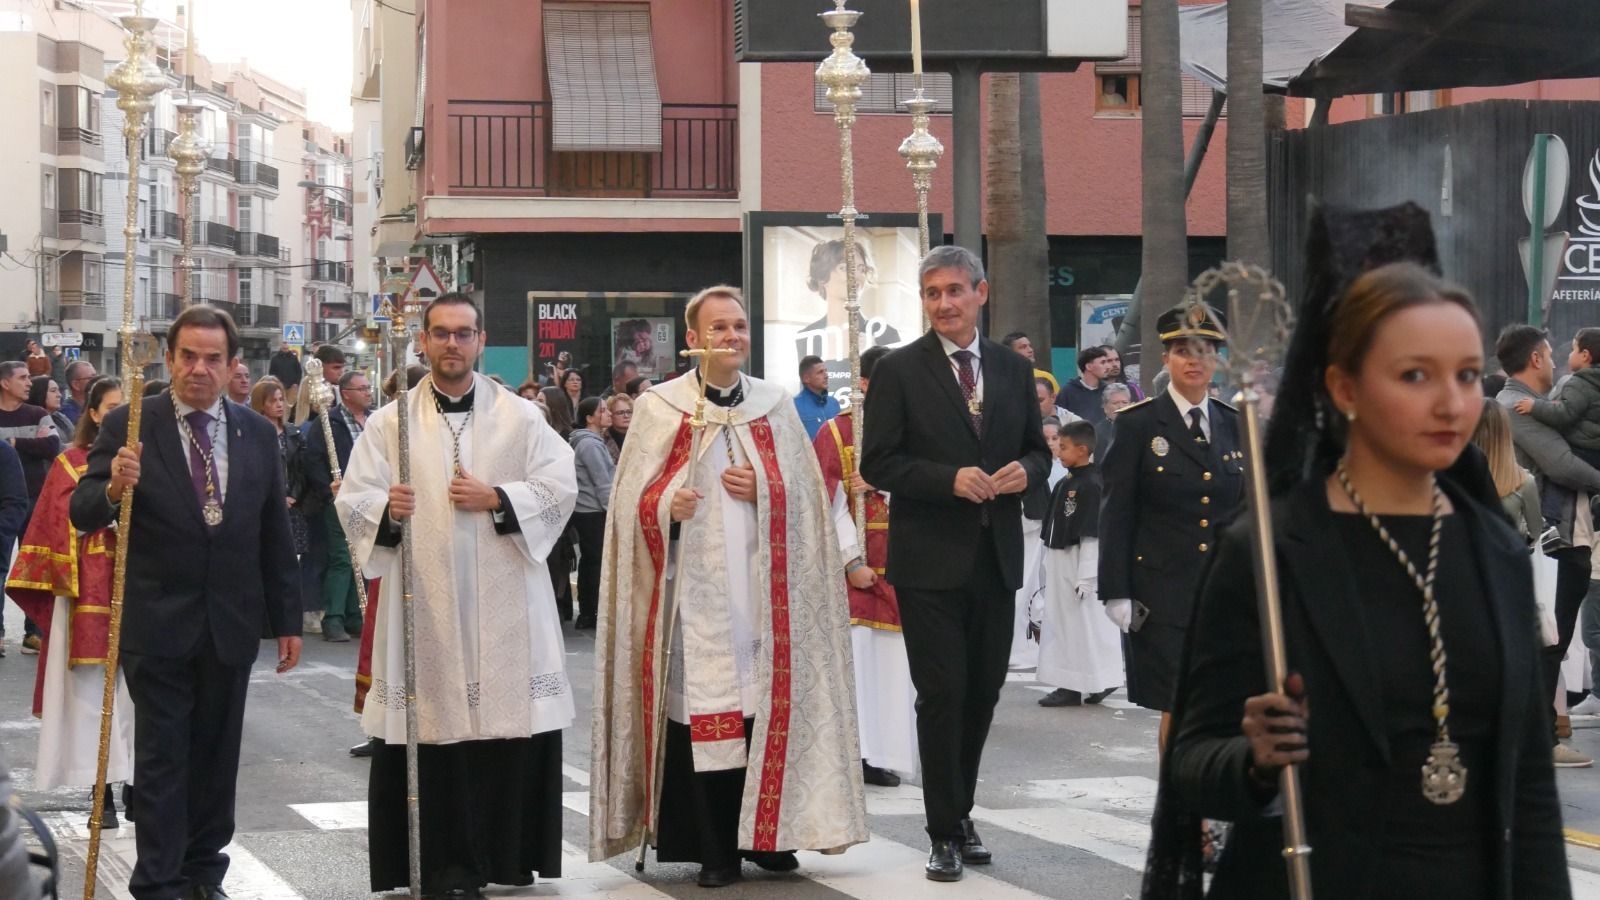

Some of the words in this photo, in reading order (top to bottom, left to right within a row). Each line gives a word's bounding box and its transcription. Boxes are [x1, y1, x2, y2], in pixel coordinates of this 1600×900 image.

[1564, 243, 1600, 274] CE
[1552, 287, 1600, 301] AFETERÍA
[538, 304, 577, 320] BLACK
[1102, 306, 1128, 318] CENT
[538, 319, 577, 340] FRIDAY
[826, 371, 852, 379] EMPR
